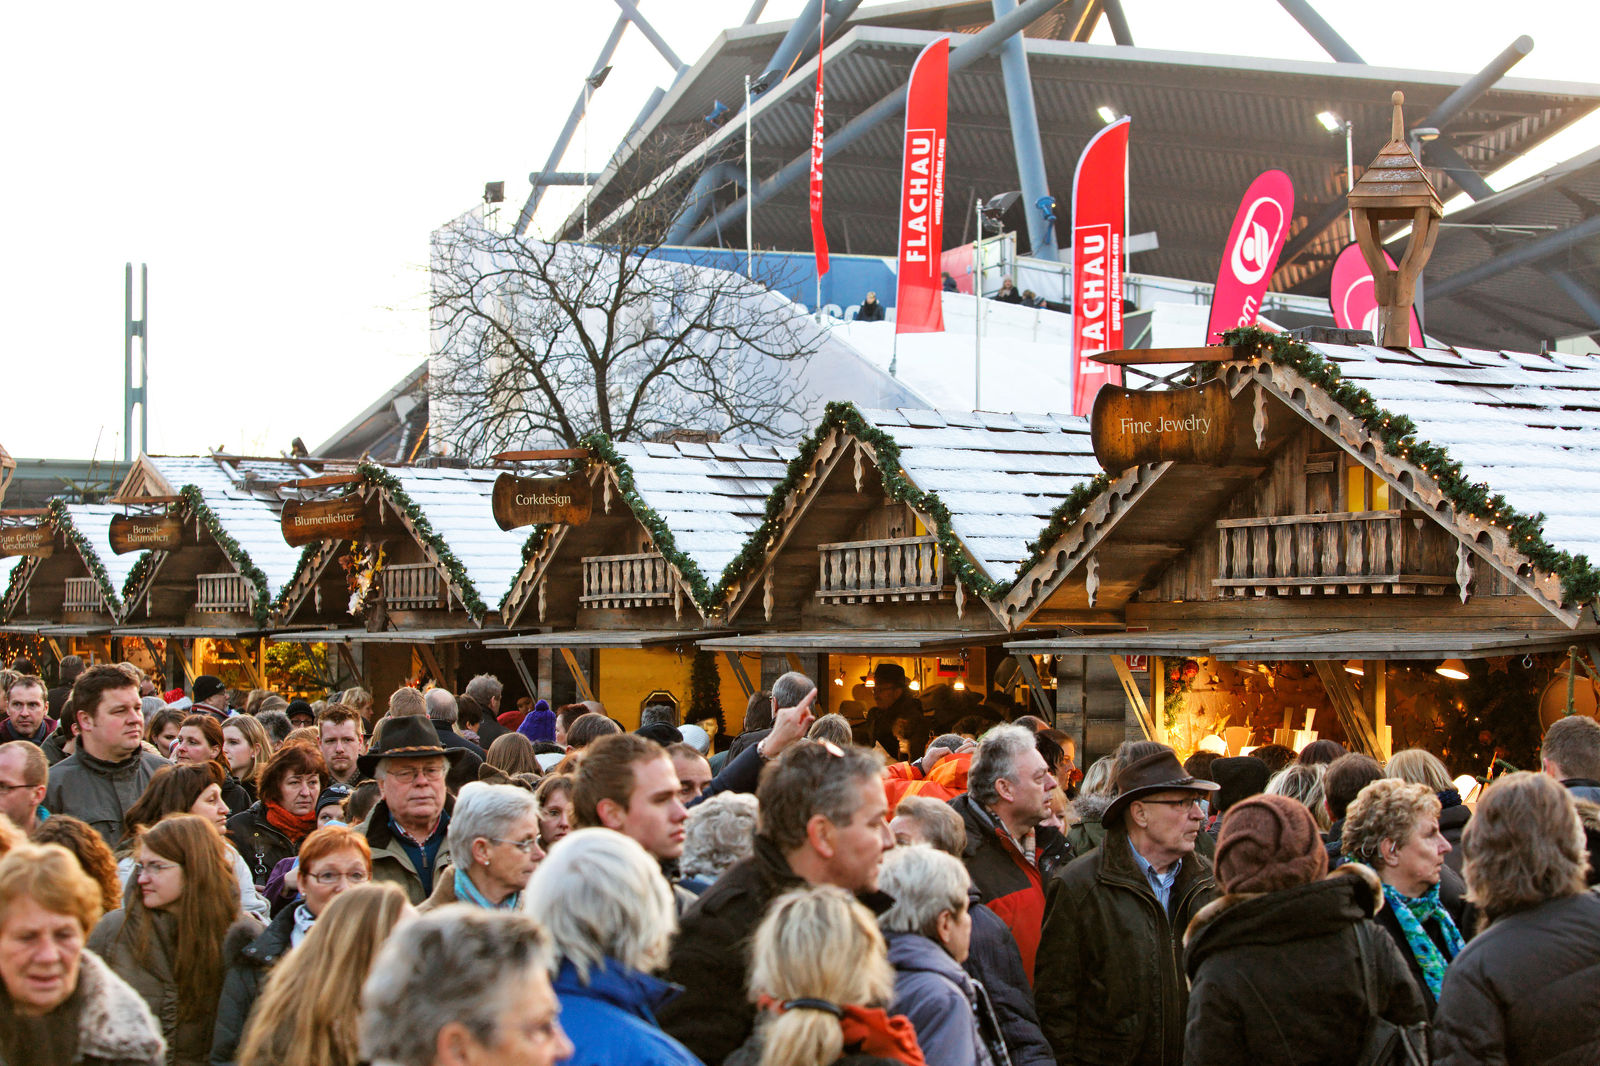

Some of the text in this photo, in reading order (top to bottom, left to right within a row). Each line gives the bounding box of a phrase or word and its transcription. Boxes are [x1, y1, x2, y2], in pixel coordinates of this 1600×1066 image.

[934, 138, 945, 225] www.flachau.com
[906, 138, 931, 262] FLACHAU
[1111, 233, 1121, 331] www.flachau.com
[1080, 234, 1105, 375] FLACHAU
[1120, 413, 1212, 435] Fine Jewelry
[515, 493, 571, 507] Corkdesign
[132, 524, 163, 534] Bonsai-
[294, 512, 355, 527] Blumenlichter
[2, 541, 39, 550] Geschenke
